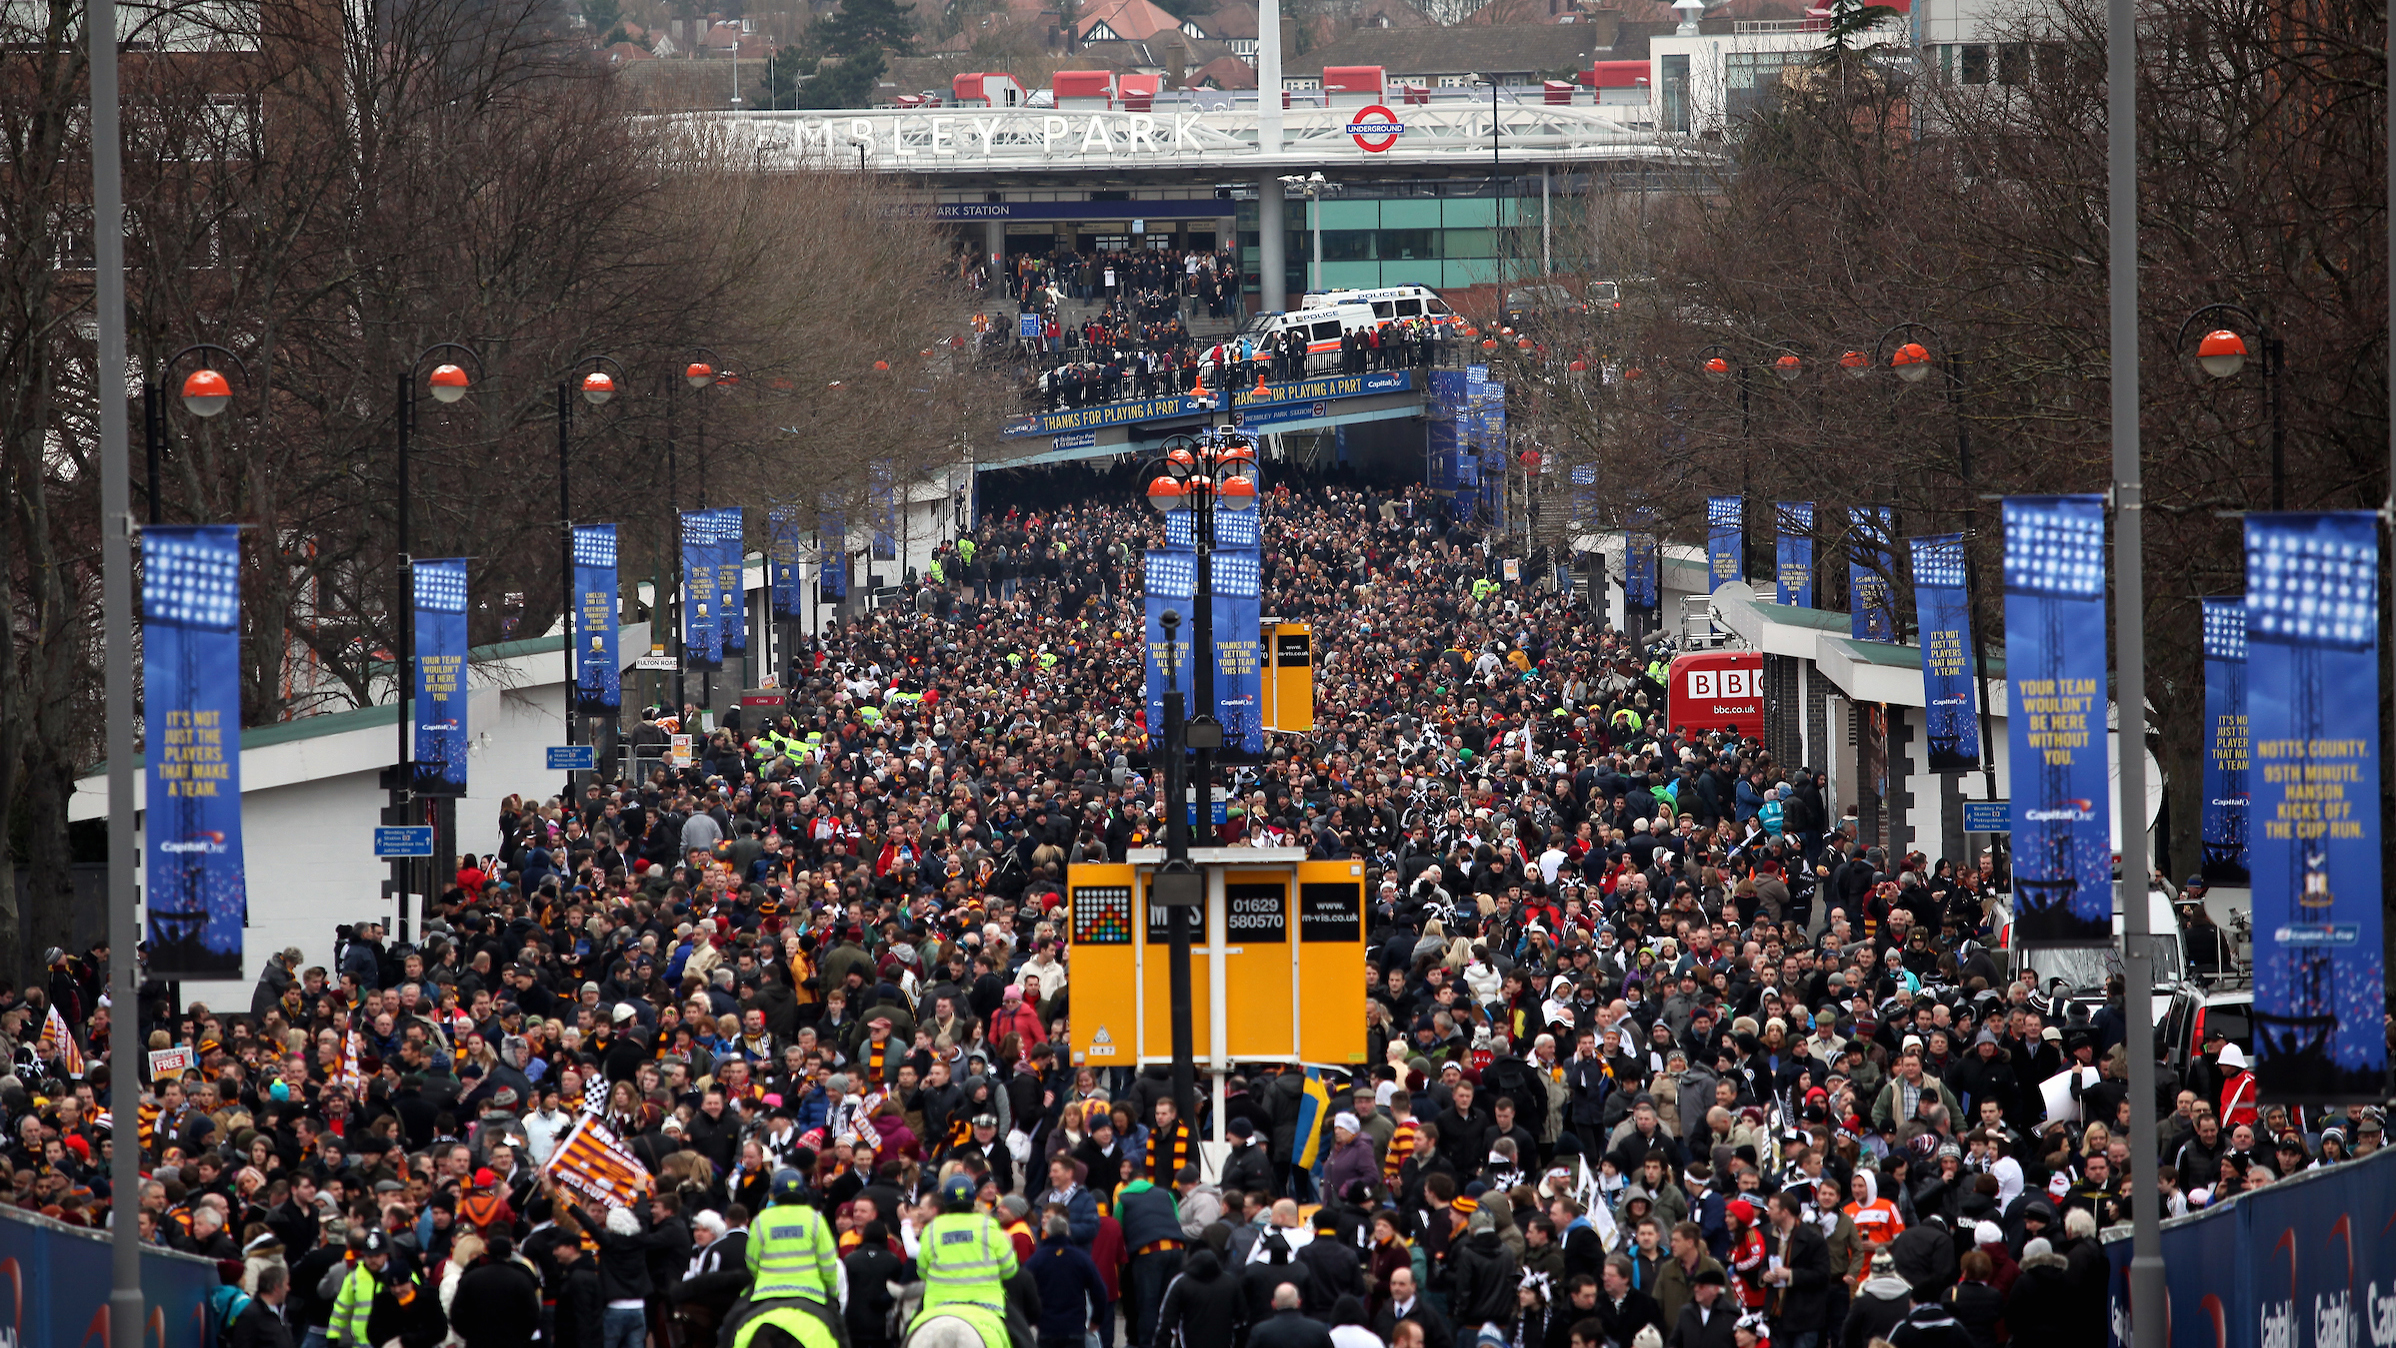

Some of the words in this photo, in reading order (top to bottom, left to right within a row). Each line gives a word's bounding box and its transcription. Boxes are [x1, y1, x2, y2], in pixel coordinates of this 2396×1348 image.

[794, 113, 1001, 156] MBLEY
[1042, 111, 1204, 152] PARK
[1348, 124, 1402, 133] UNDERGROUND
[963, 206, 1009, 215] STATION
[1357, 291, 1397, 299] POLICE
[1303, 310, 1339, 320] POLICE
[1288, 382, 1326, 400] PLAYING
[1330, 381, 1336, 395] A
[1338, 378, 1361, 393] PART
[1043, 414, 1081, 431] THANKS
[1083, 410, 1102, 425] FOR
[1104, 404, 1144, 423] PLAYING
[1147, 402, 1154, 417] A
[1155, 399, 1180, 415] PART
[1245, 412, 1271, 422] WEMBLEY
[1273, 411, 1287, 419] PARK
[1290, 408, 1312, 416] STATION
[1930, 631, 1944, 640] IT'S
[1945, 630, 1959, 639] NOT
[1176, 642, 1189, 650] FOR
[1243, 641, 1256, 649] FOR
[1930, 641, 1946, 649] JUST
[1948, 640, 1961, 648] THE
[1223, 650, 1250, 658] GETTING
[1931, 649, 1962, 658] PLAYERS
[421, 656, 440, 665] YOUR
[441, 656, 461, 664] TEAM
[1237, 658, 1255, 666] TEAM
[1928, 659, 1945, 667] THAT
[1947, 658, 1966, 666] MAKE
[422, 665, 459, 674] WOULDN'T
[1221, 667, 1236, 675] THIS
[1238, 666, 1252, 674] FAR.
[1934, 668, 1939, 676] A
[1941, 667, 1961, 676] TEAM.
[426, 674, 435, 683] BE
[437, 674, 456, 683] HERE
[424, 683, 457, 692] WITHOUT
[1696, 674, 1763, 694] BB
[2019, 680, 2056, 696] YOUR
[2059, 679, 2096, 695] TEAM
[433, 693, 448, 701] YOU.
[1713, 704, 1756, 714] bbc.co.uk
[2022, 697, 2093, 713] WOULDN'T
[166, 711, 191, 727] IT'S
[194, 711, 219, 727] NOT
[2030, 715, 2048, 730] BE
[2051, 714, 2087, 730] HERE
[2218, 715, 2234, 725] IT'S
[2236, 715, 2248, 725] NO
[422, 723, 459, 731] CapitalOne
[2216, 727, 2236, 736] JUST
[2238, 727, 2249, 736] TH
[164, 729, 193, 744] JUST
[198, 729, 222, 744] THE
[2028, 732, 2089, 748] WITHOUT
[2216, 738, 2249, 747] PLAYER
[2257, 739, 2305, 758] NOTTS
[2308, 739, 2370, 758] COUNTY.
[164, 746, 223, 762] PLAYERS
[2043, 750, 2075, 765] YOU.
[2212, 749, 2233, 759] THAT
[2235, 749, 2250, 759] MA
[2218, 760, 2224, 770] A
[158, 763, 189, 779] THAT
[192, 763, 229, 779] MAKE
[2263, 764, 2301, 783] 95TH
[2304, 763, 2364, 782] MINUTE.
[167, 781, 178, 797] A
[181, 781, 219, 797] TEAM.
[2285, 783, 2344, 801] HANSON
[2025, 808, 2096, 822] CapitalOne
[2277, 802, 2321, 820] KICKS
[2324, 802, 2352, 819] OFF
[2264, 821, 2292, 839] THE
[2296, 821, 2327, 839] CUP
[2330, 820, 2365, 839] RUN.
[160, 841, 228, 853] CapitalOne
[1233, 899, 1279, 913] 01629
[1316, 903, 1345, 911] www.
[1229, 915, 1284, 929] 580570
[1301, 912, 1359, 923] m-vis.co.uk
[155, 1056, 182, 1071] FREE
[583, 1181, 607, 1200] CUP
